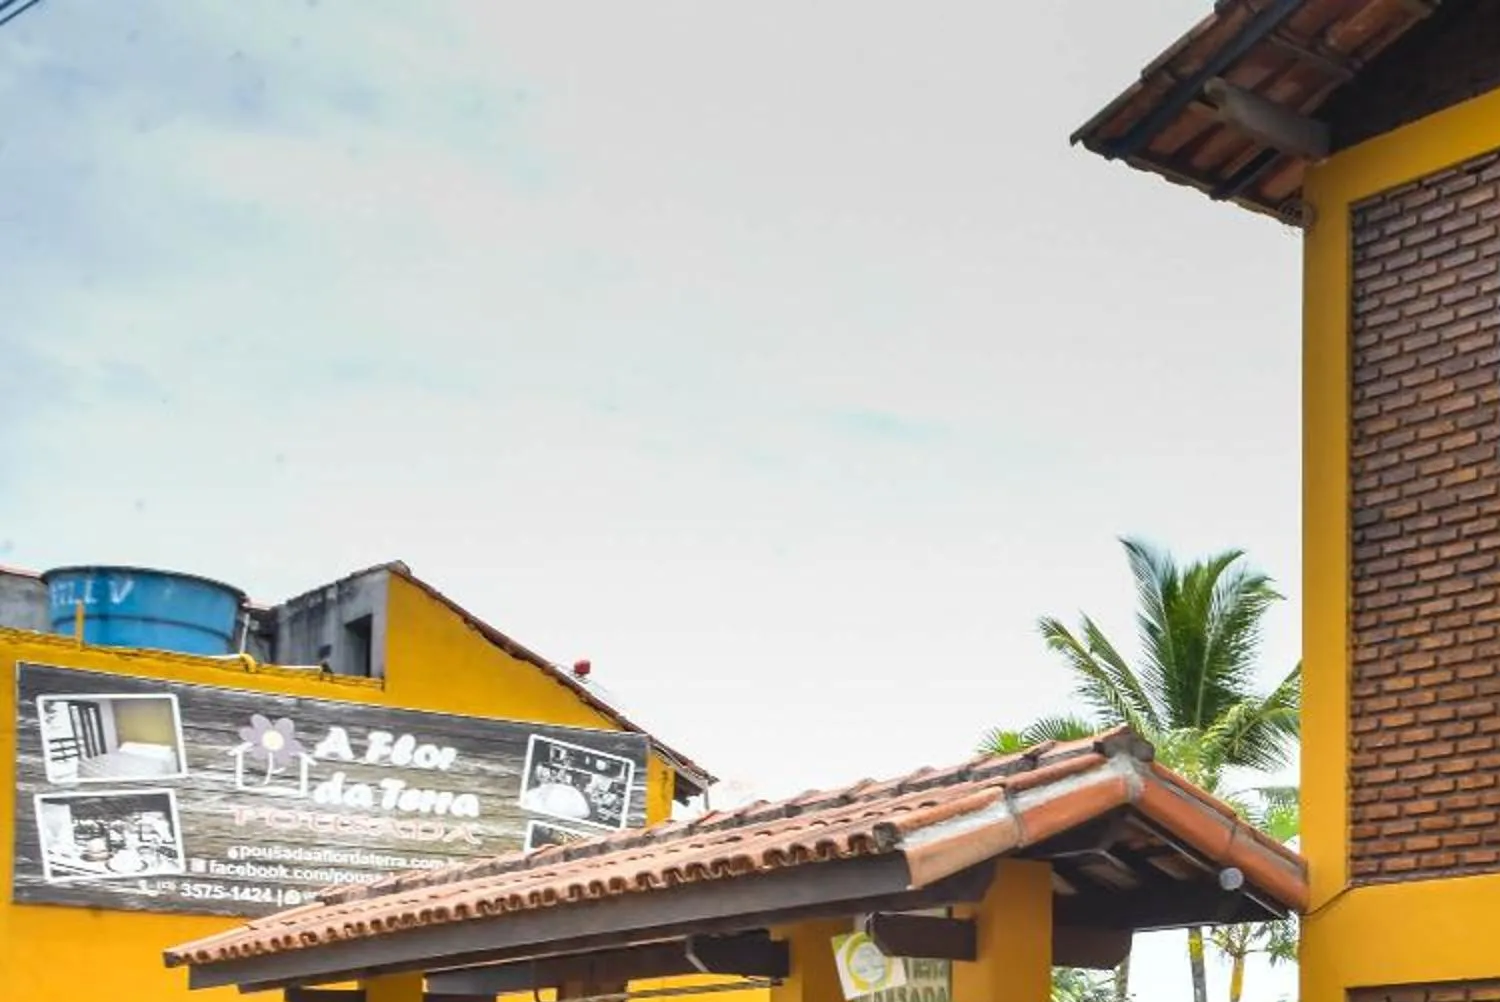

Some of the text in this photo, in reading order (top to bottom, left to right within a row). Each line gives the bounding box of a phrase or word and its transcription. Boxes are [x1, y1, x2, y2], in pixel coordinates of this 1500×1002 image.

[314, 726, 458, 771] A Flor
[312, 771, 480, 818] da Terra
[230, 805, 482, 845] POUSADA
[181, 881, 272, 901] 3575-1424
